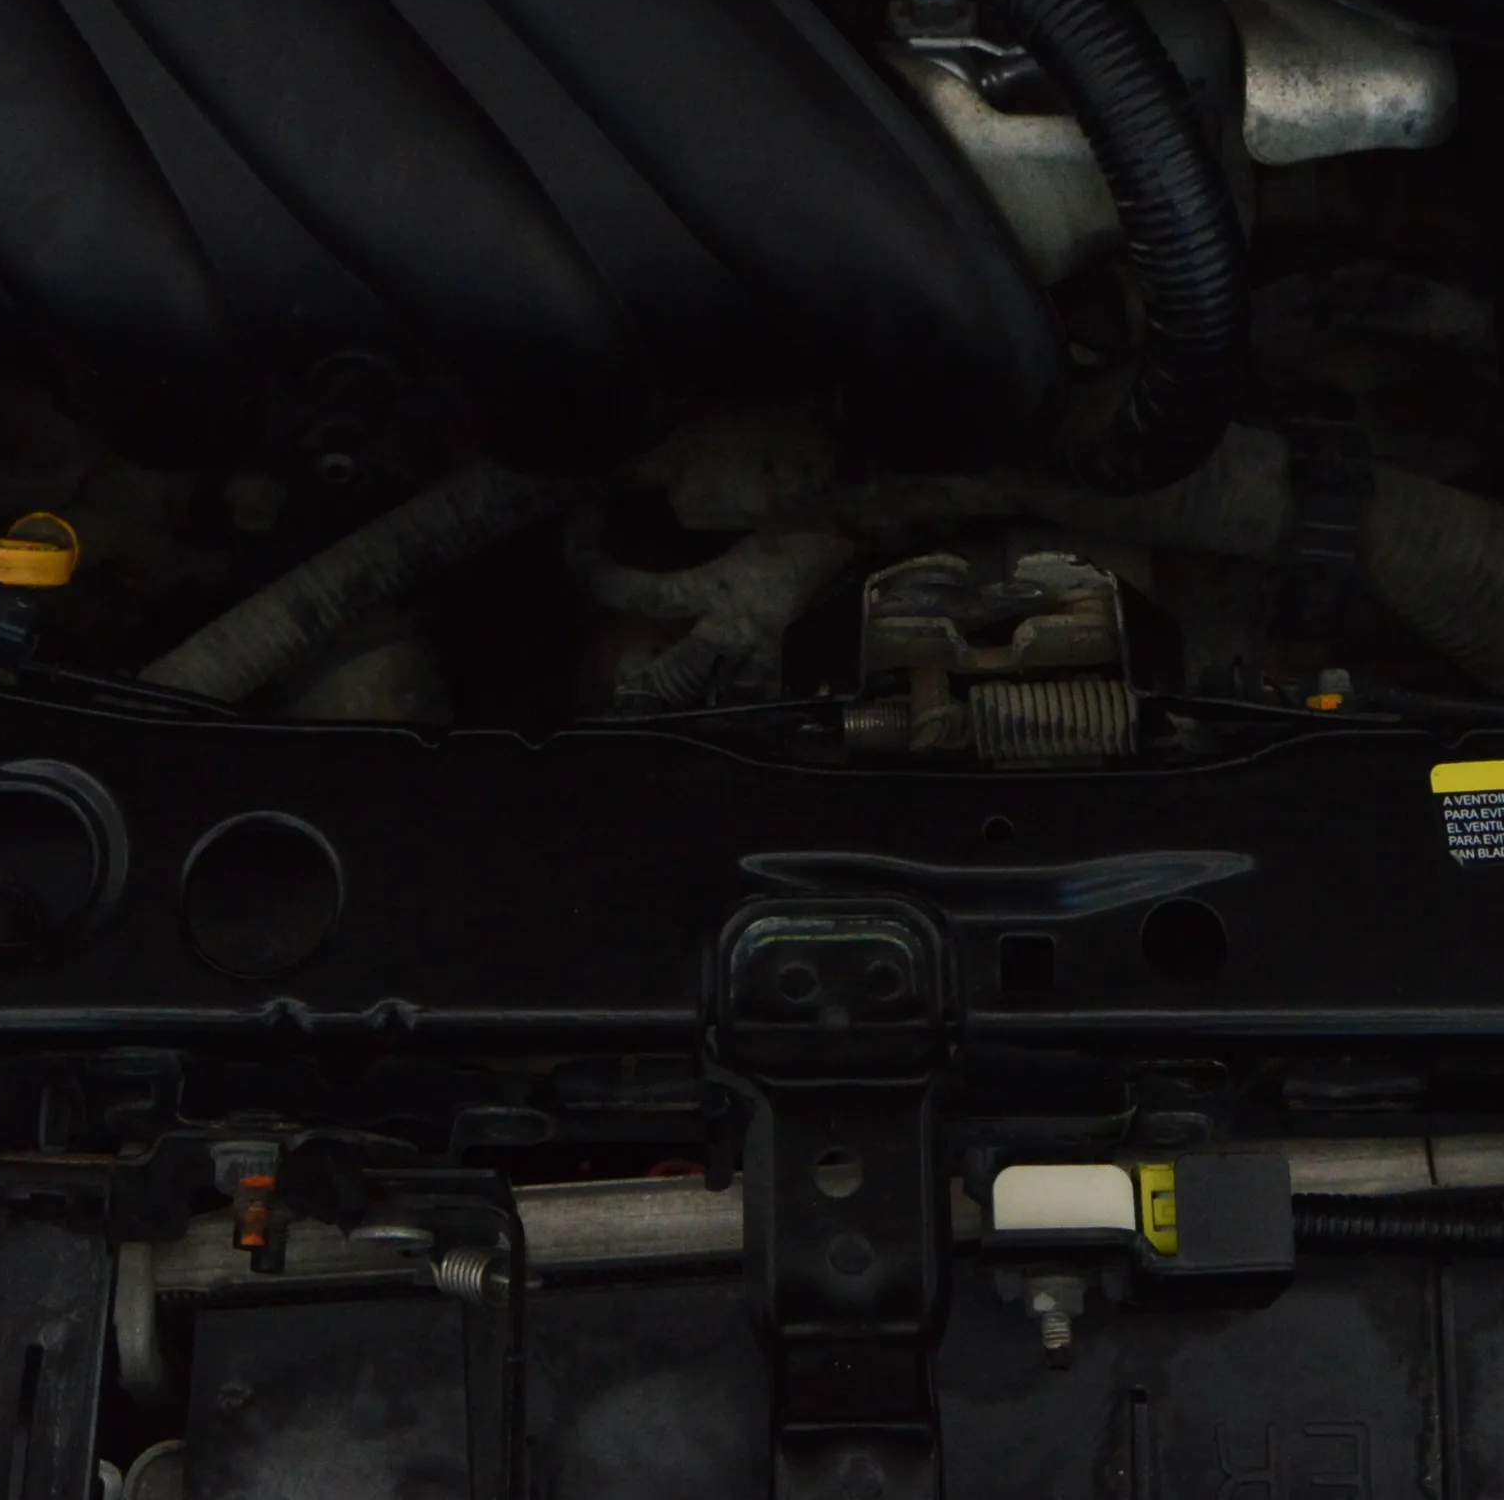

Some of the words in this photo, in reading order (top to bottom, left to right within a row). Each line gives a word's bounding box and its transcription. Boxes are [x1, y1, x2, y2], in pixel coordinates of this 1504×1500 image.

[1444, 795, 1453, 807] A
[1445, 808, 1478, 821] PARA
[1447, 822, 1460, 834] EL
[1448, 834, 1481, 846] PARA
